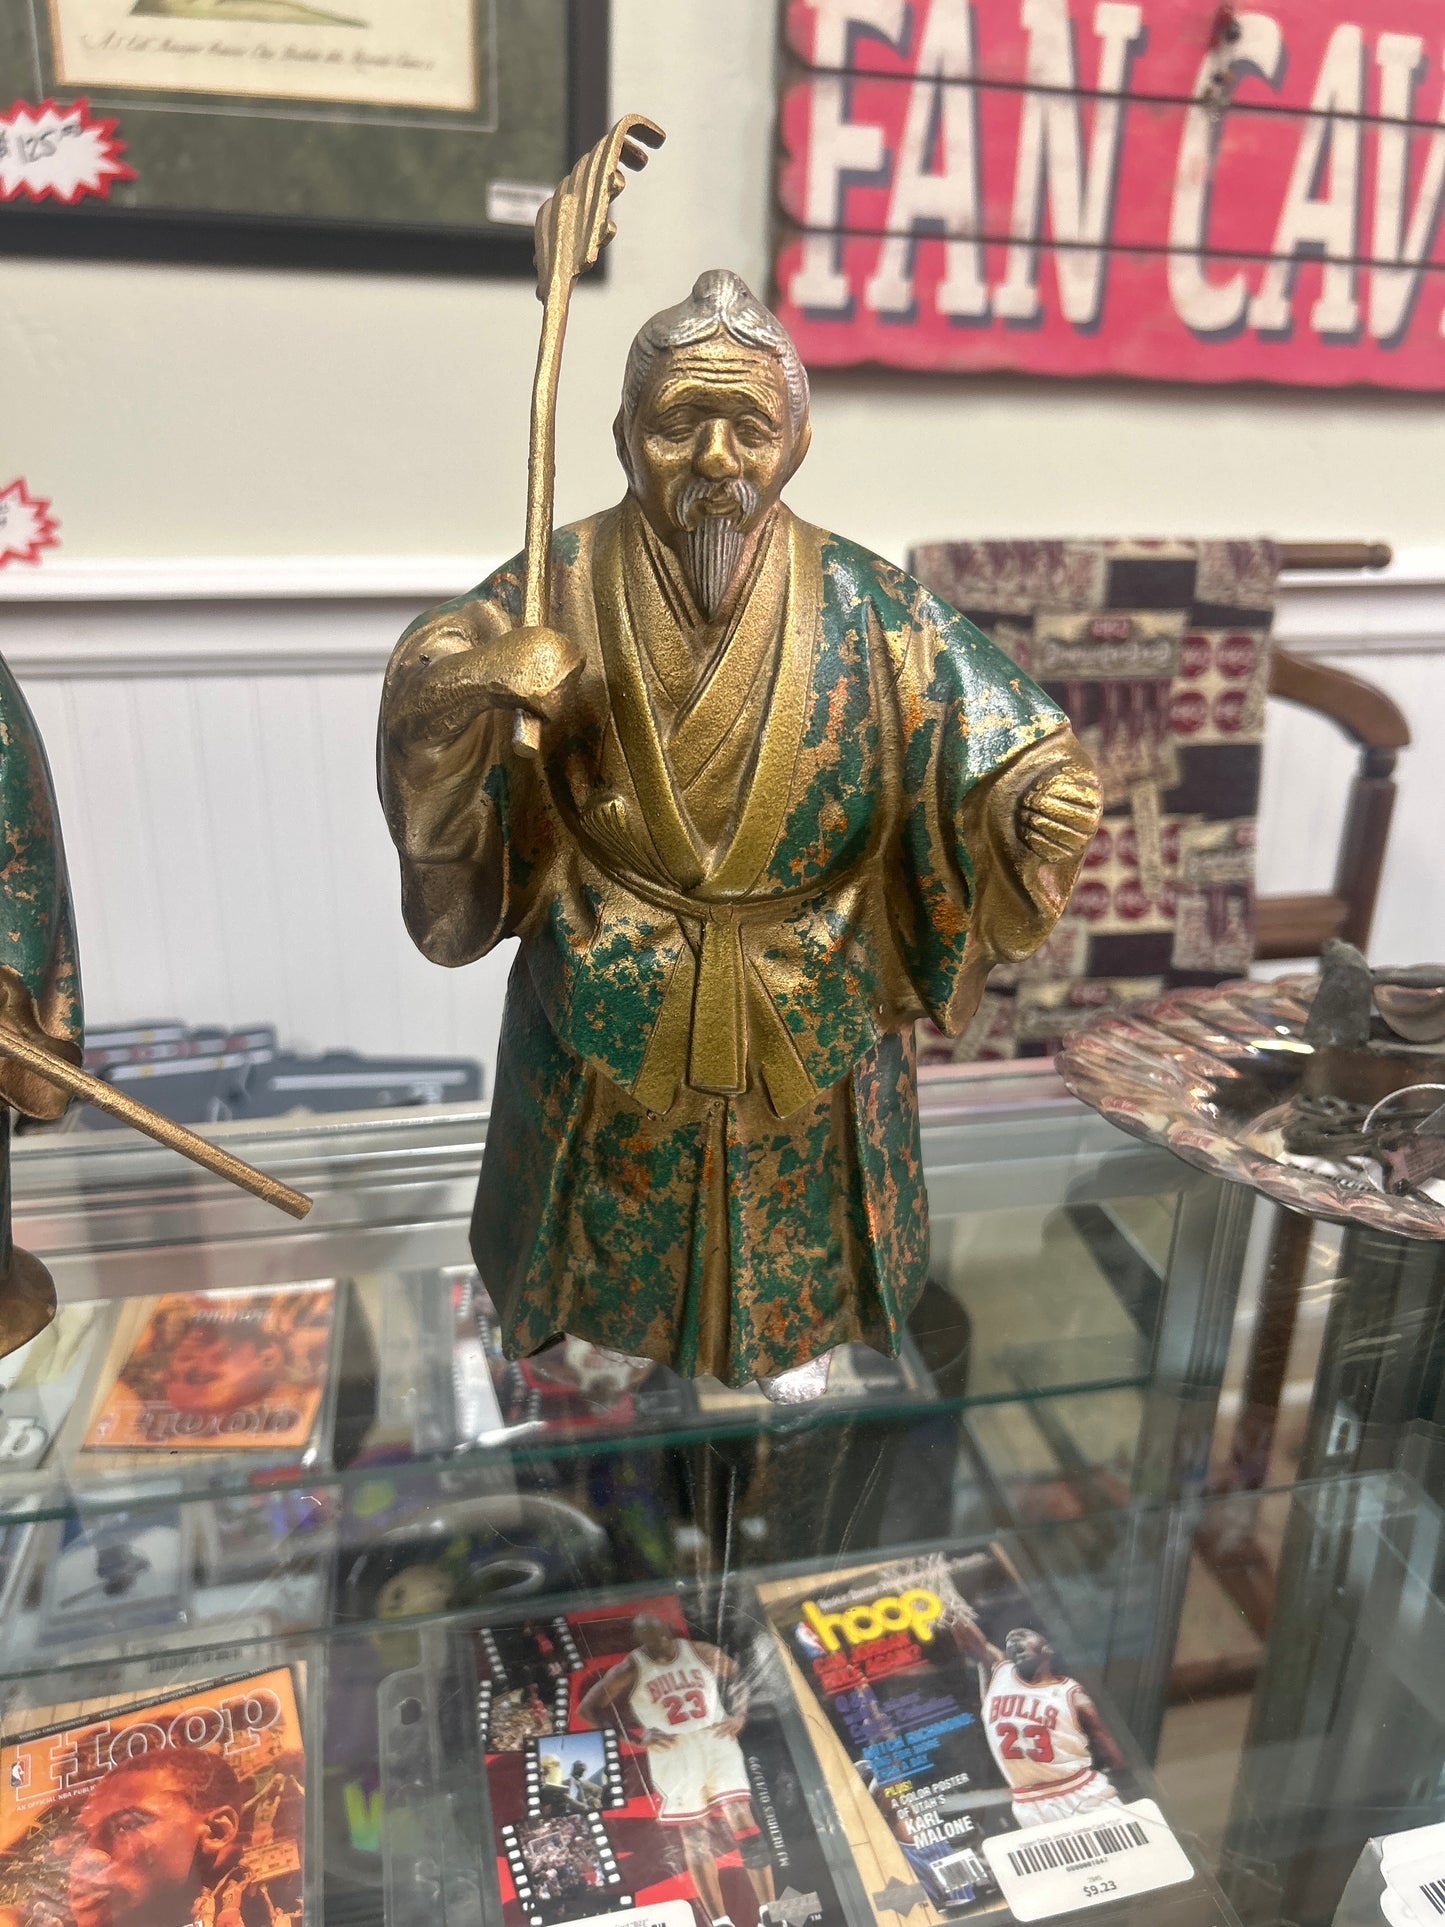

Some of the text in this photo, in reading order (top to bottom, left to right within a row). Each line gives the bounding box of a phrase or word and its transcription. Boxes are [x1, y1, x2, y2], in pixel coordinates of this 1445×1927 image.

[790, 0, 1445, 340] FAN CAV
[802, 1588, 943, 1651] hoop
[647, 1668, 705, 1704] BULLS
[663, 1690, 707, 1725] 23
[989, 1694, 1059, 1730] BULLS
[995, 1722, 1055, 1763] 23
[931, 1773, 970, 1794] POSTER
[905, 1810, 944, 1836] KARL
[913, 1815, 975, 1850] MALONE
[1083, 1880, 1117, 1897] $9.23
